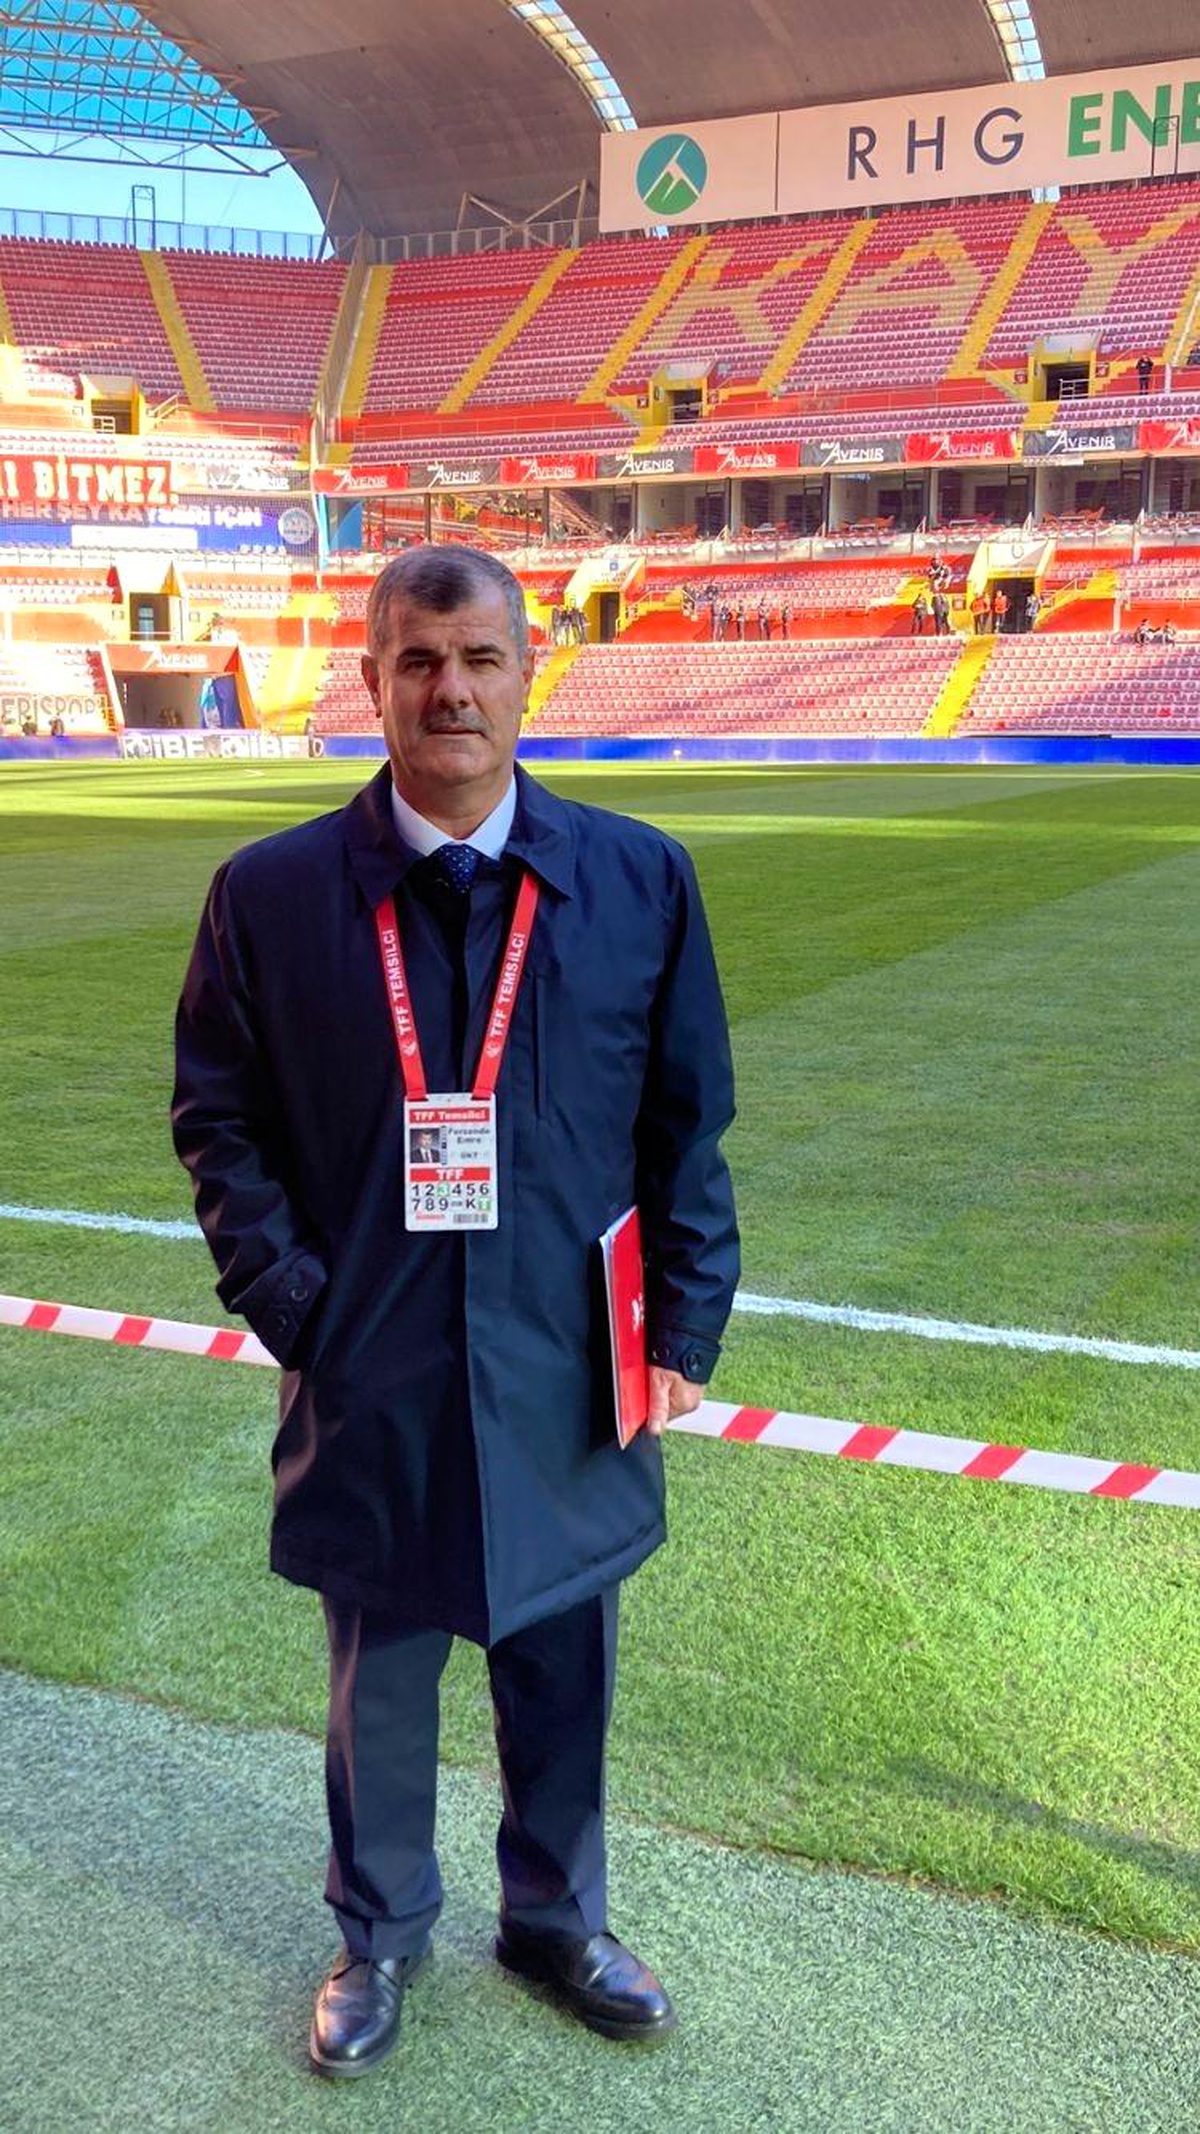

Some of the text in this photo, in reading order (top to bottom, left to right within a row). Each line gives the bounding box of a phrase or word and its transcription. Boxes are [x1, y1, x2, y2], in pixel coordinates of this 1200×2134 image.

[820, 442, 884, 468] AVENIR
[931, 435, 995, 460] AVENIR
[1047, 429, 1116, 457] AVENIR
[428, 465, 482, 489] AVENIR
[616, 454, 674, 479] AVENIR
[334, 469, 389, 491] AVENIR
[395, 1005, 412, 1036] TFF
[490, 1008, 506, 1038] TFF
[436, 1169, 464, 1180] TFF
